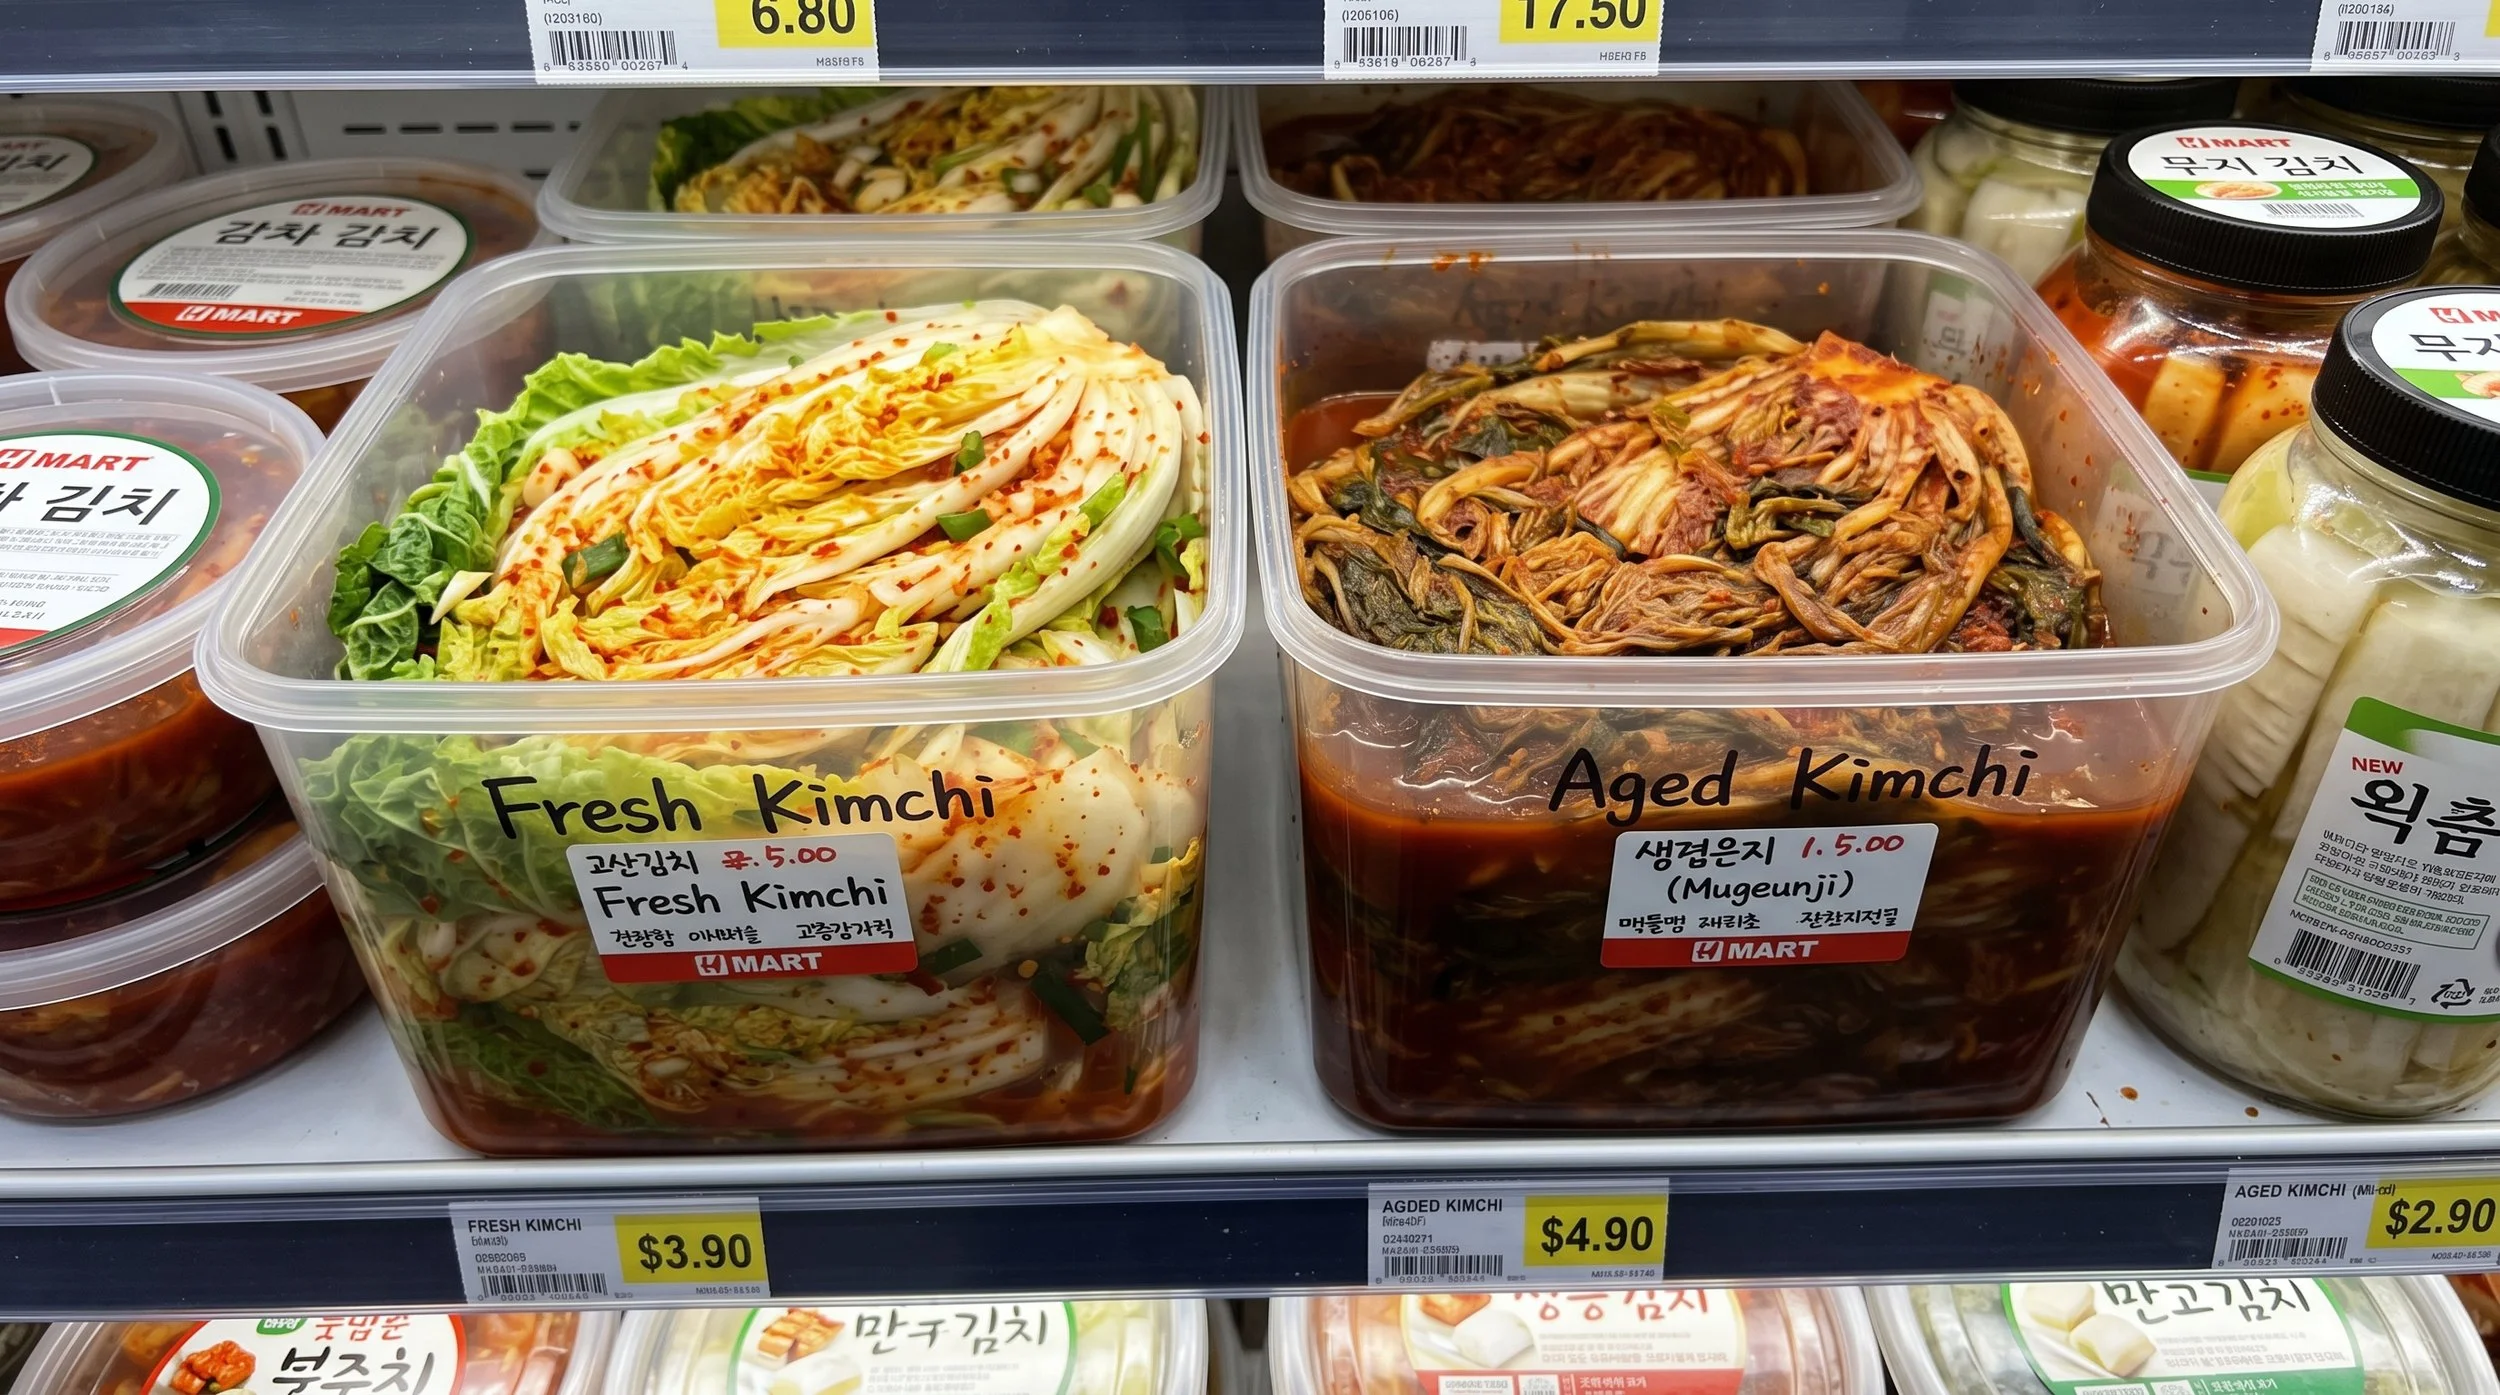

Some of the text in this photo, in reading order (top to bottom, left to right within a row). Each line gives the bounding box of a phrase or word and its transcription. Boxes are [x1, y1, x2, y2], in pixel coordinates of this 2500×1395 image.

[2211, 138, 2292, 148] MART
[2161, 155, 2364, 176] 무지 김치
[327, 206, 411, 218] MART
[210, 308, 303, 324] MART
[32, 453, 152, 472] MART
[41, 485, 181, 526] 김치
[2352, 757, 2403, 774] NEW
[1548, 744, 2038, 827] Aged Kimchi
[482, 769, 995, 839] Fresh Kimchi
[592, 876, 888, 918] Fresh Kimchi
[1667, 870, 1854, 906] (Mugeunji)
[1728, 941, 1819, 960] MART
[732, 952, 822, 973] MART
[2235, 1184, 2283, 1198] AGED
[2287, 1183, 2347, 1197] KIMCHI
[1382, 1199, 1503, 1213] AGDED KIMCHI
[468, 1218, 582, 1232] FRESH KIMCHI
[2385, 1198, 2496, 1239] $2.90
[1541, 1215, 1654, 1257] $4.90
[638, 1233, 752, 1274] $3.90
